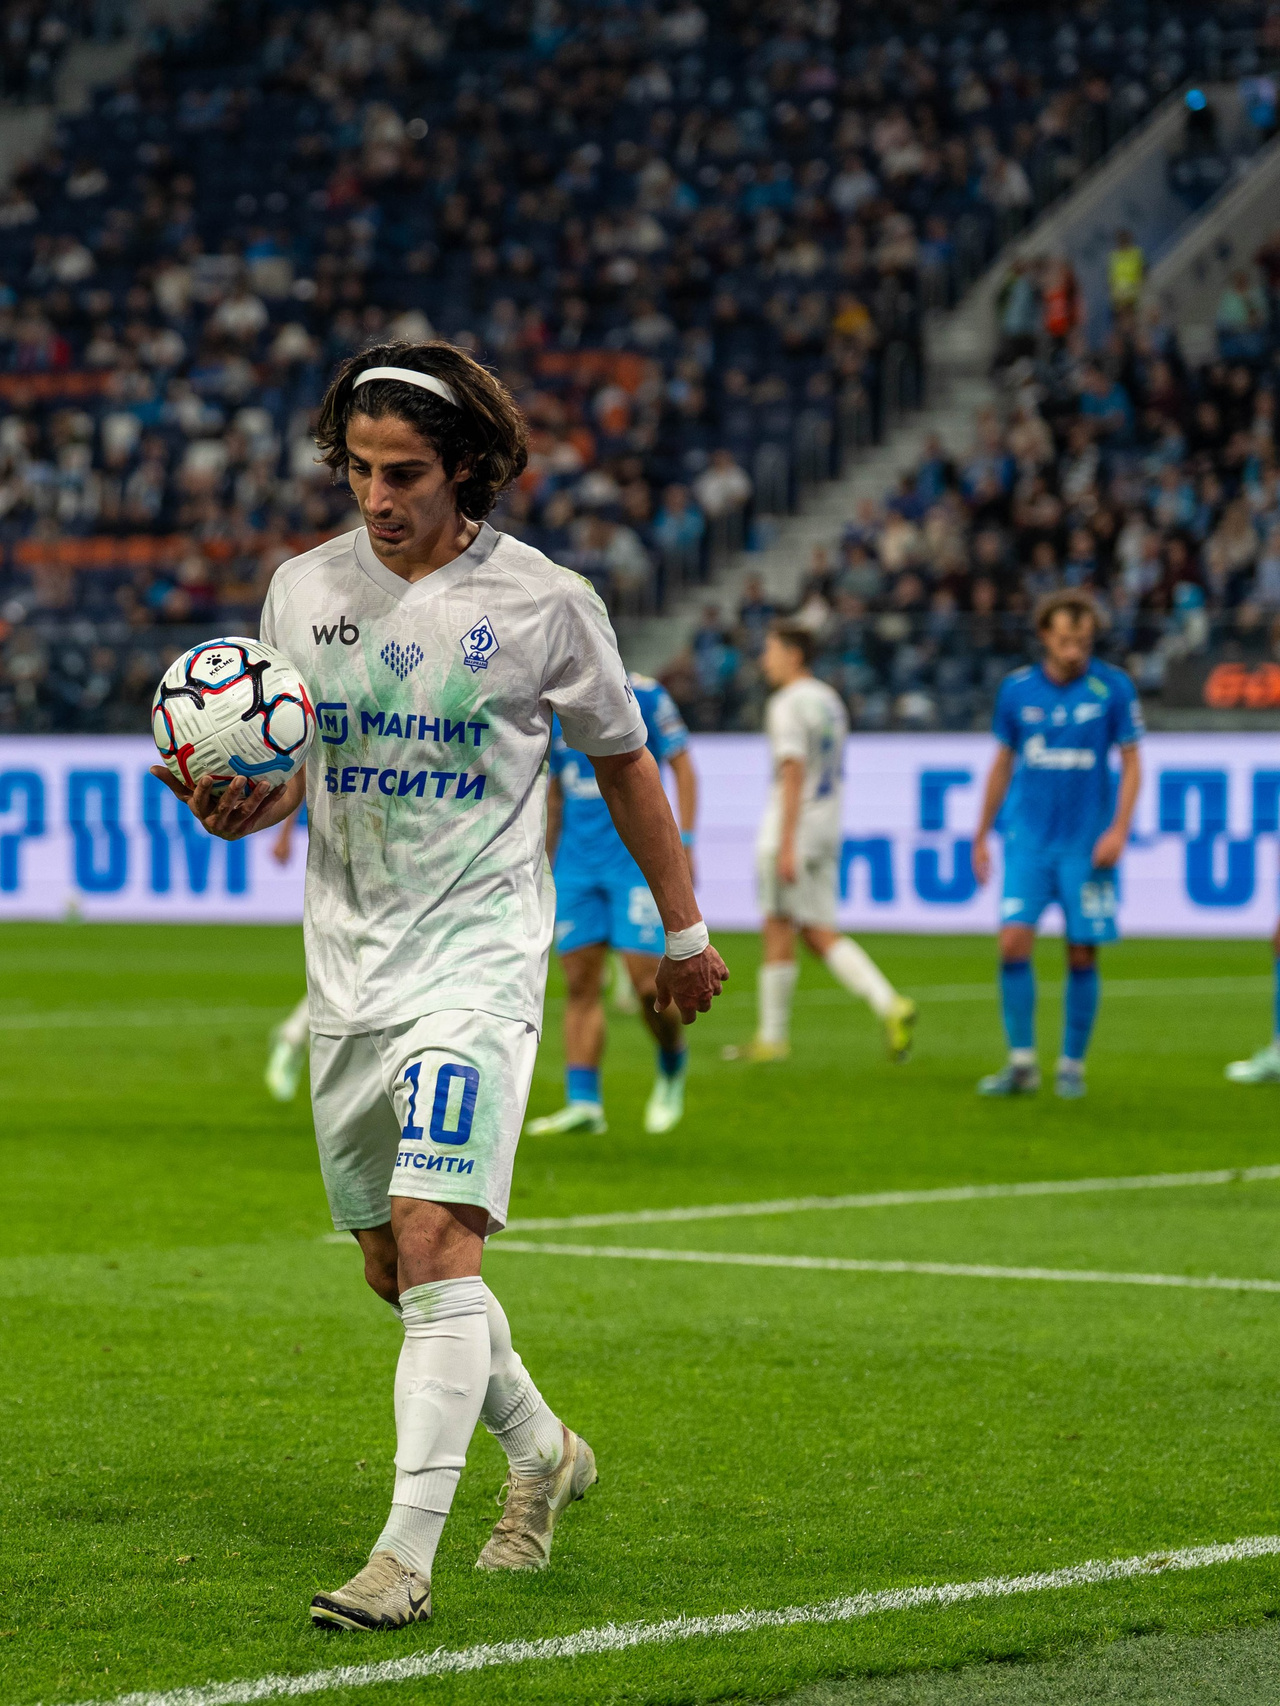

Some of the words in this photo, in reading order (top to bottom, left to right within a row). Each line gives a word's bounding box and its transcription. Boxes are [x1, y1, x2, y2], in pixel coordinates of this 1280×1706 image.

[312, 615, 360, 646] wb
[209, 657, 235, 676] KELME
[360, 711, 490, 747] МАГНИТ
[325, 766, 487, 800] БЕТСИТИ
[401, 1061, 480, 1146] 10
[396, 1152, 475, 1175] ЕТСИТИ
